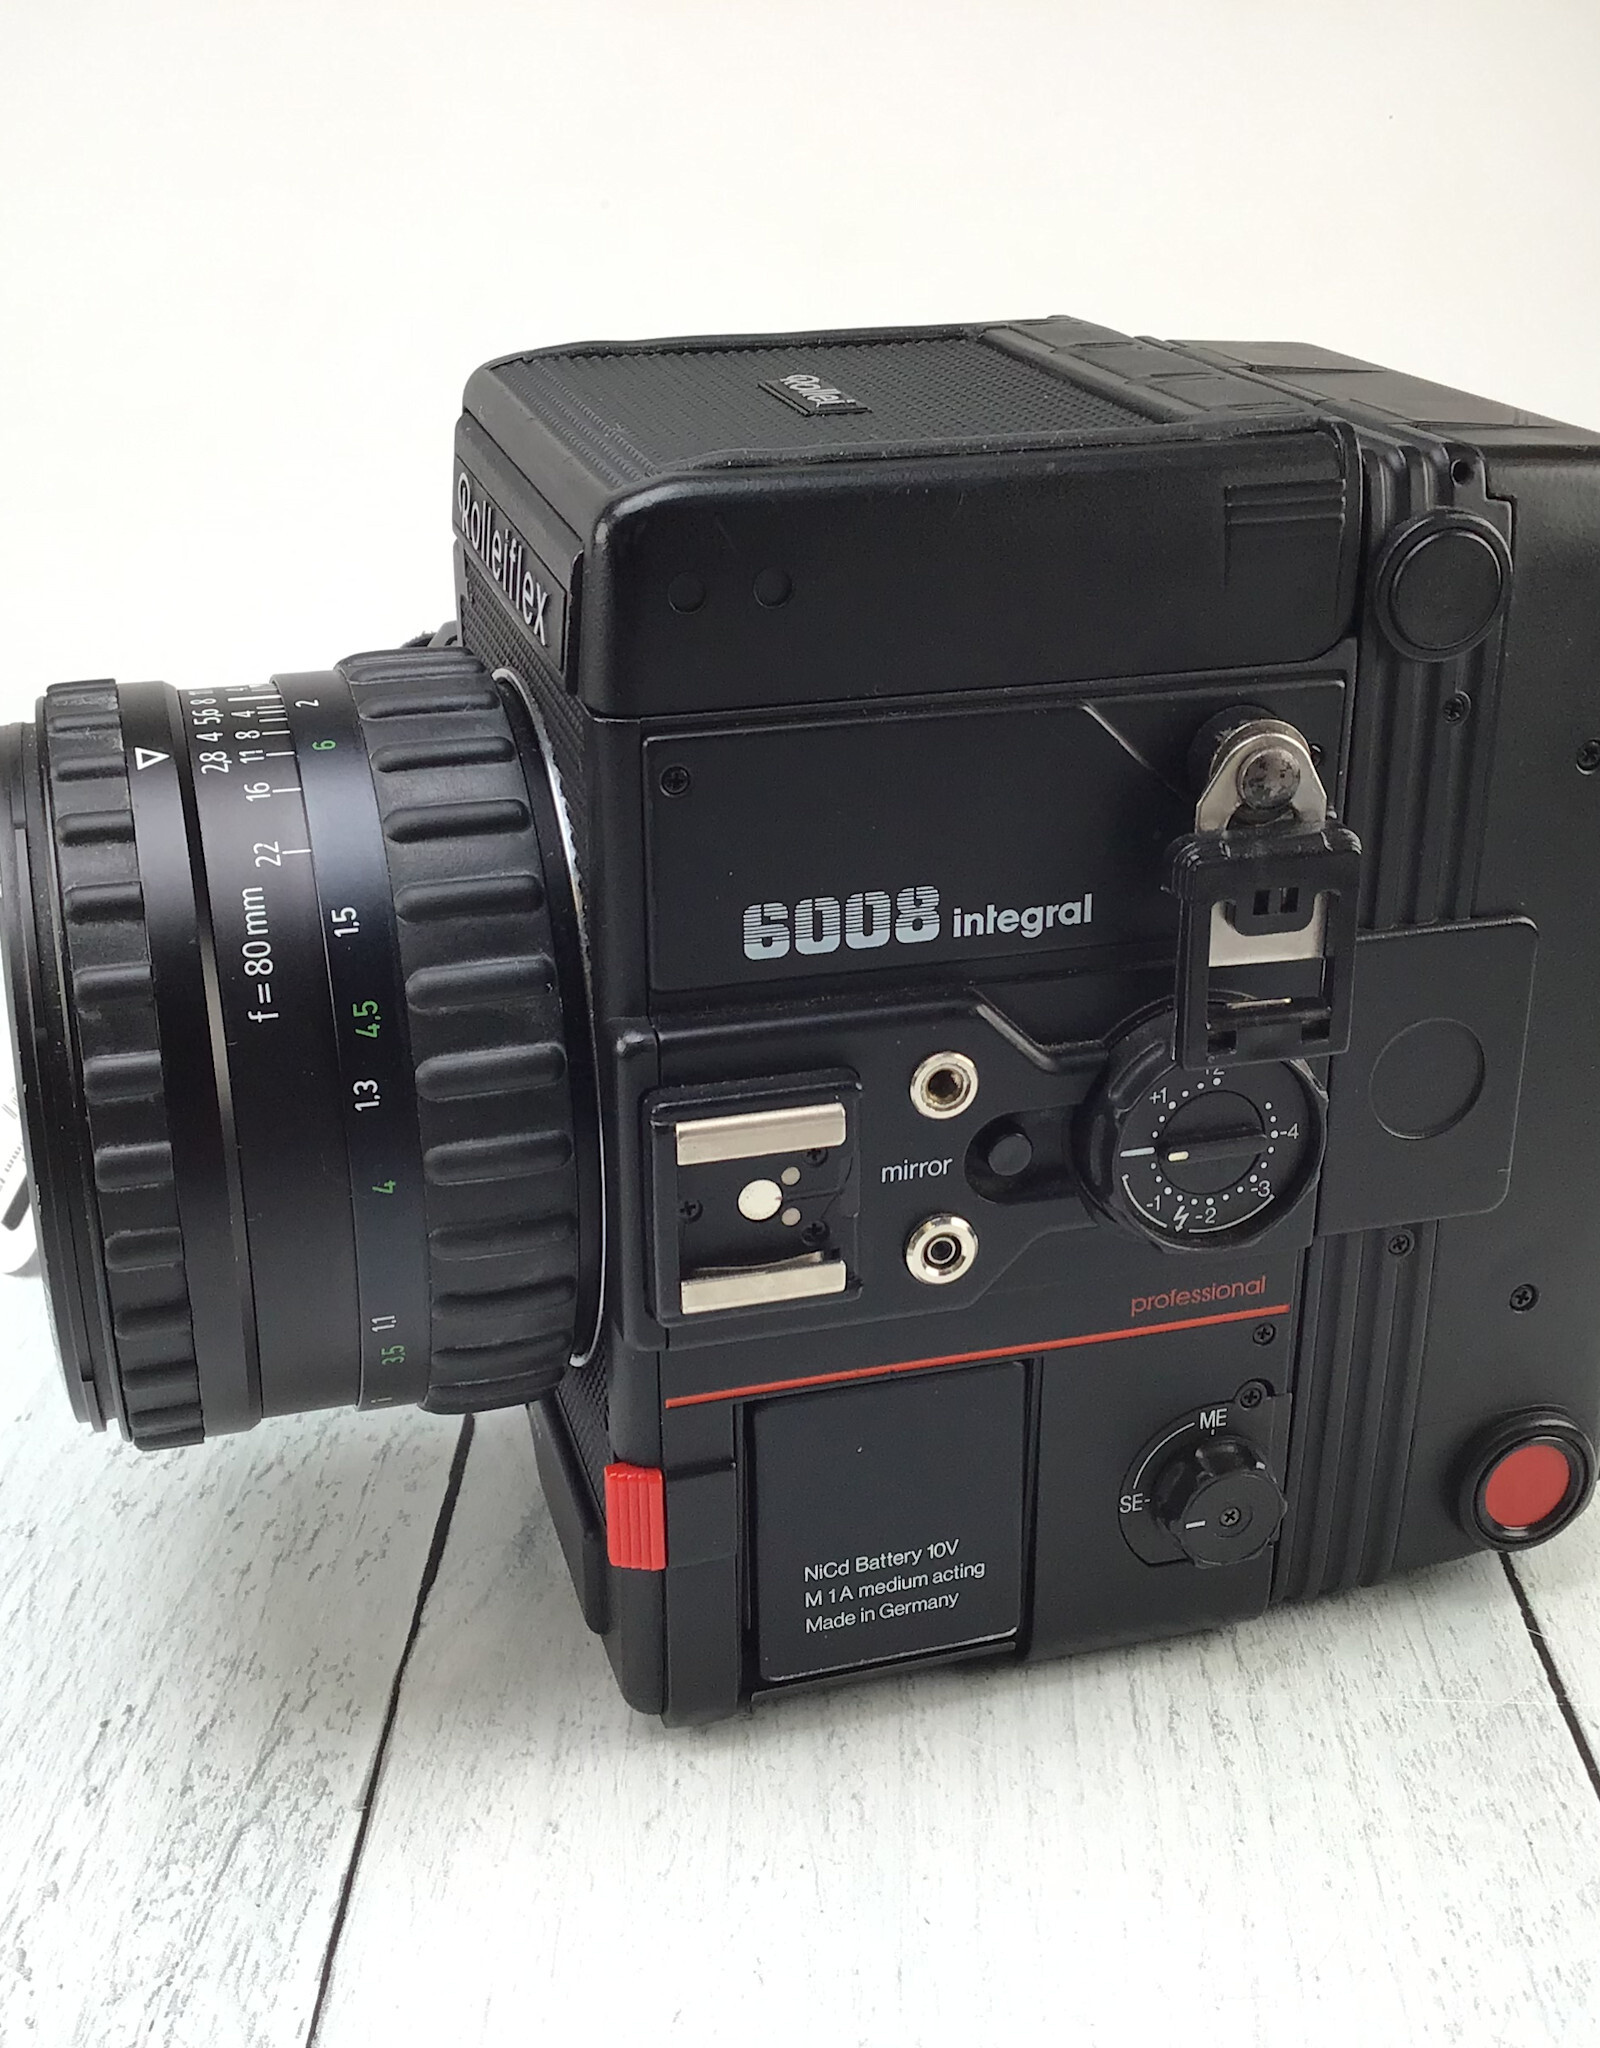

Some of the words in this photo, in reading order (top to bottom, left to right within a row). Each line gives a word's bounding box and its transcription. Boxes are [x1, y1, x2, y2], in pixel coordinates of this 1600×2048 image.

[780, 374, 857, 407] Rollei
[458, 472, 548, 646] Rolleiflex
[190, 698, 217, 706] 8
[294, 699, 320, 708] 2
[231, 710, 256, 718] 4
[196, 732, 223, 742] 4
[235, 730, 260, 739] 8
[312, 740, 336, 751] 6
[239, 749, 265, 764] 11
[244, 782, 271, 802] 16
[253, 841, 281, 868] 22
[743, 885, 940, 960] 6008
[952, 893, 1092, 938] integral
[1150, 1087, 1168, 1104] +1
[1280, 1123, 1300, 1140] -4
[881, 1158, 953, 1183] mirror
[372, 1179, 396, 1194] 4
[1251, 1180, 1271, 1197] -3
[1146, 1195, 1161, 1211] -1
[1195, 1207, 1217, 1224] -2
[1131, 1275, 1267, 1317] professional
[1200, 1408, 1228, 1430] ME
[804, 1559, 850, 1583] NiCd
[855, 1549, 922, 1574] Battery
[927, 1538, 960, 1560] 10V
[805, 1589, 823, 1609] M
[858, 1573, 929, 1599] medium
[931, 1562, 986, 1585] acting
[806, 1611, 856, 1634] Made
[860, 1607, 876, 1623] in
[879, 1592, 960, 1620] Germany
